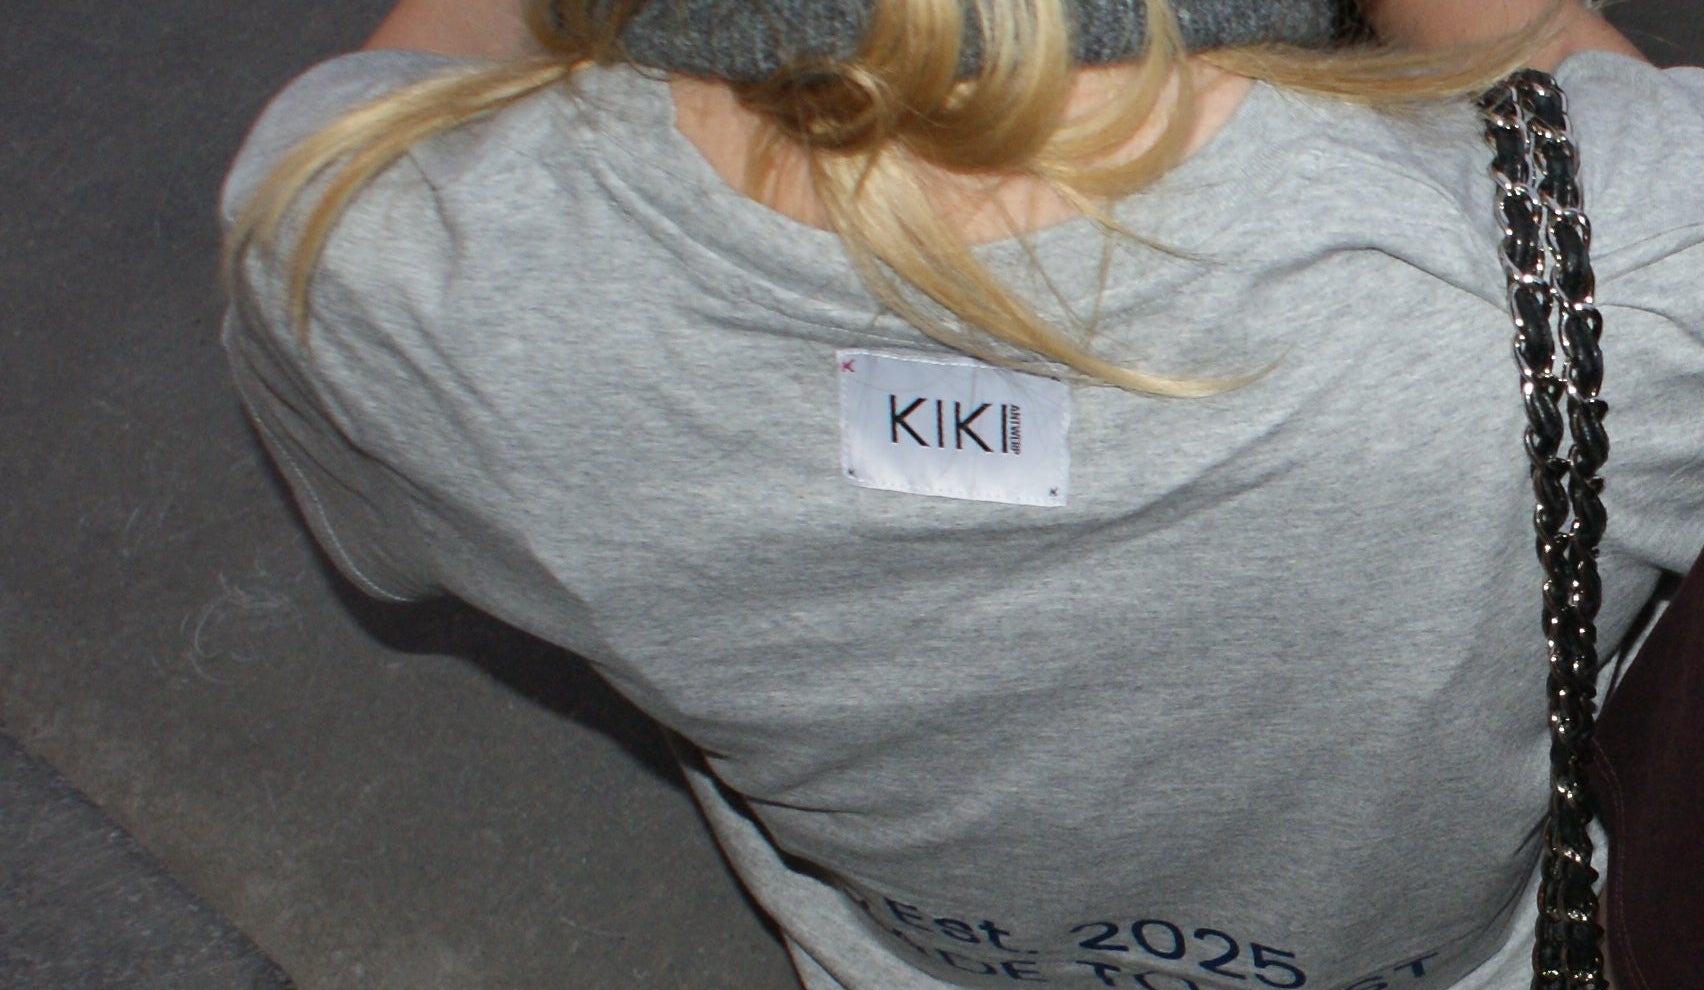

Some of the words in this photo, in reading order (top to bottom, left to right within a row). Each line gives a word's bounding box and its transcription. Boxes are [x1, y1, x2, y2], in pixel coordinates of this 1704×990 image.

[889, 394, 1009, 454] KIKI
[1009, 403, 1022, 456] ANTWERP
[883, 895, 1040, 955] Est.
[1069, 919, 1307, 990] 2025
